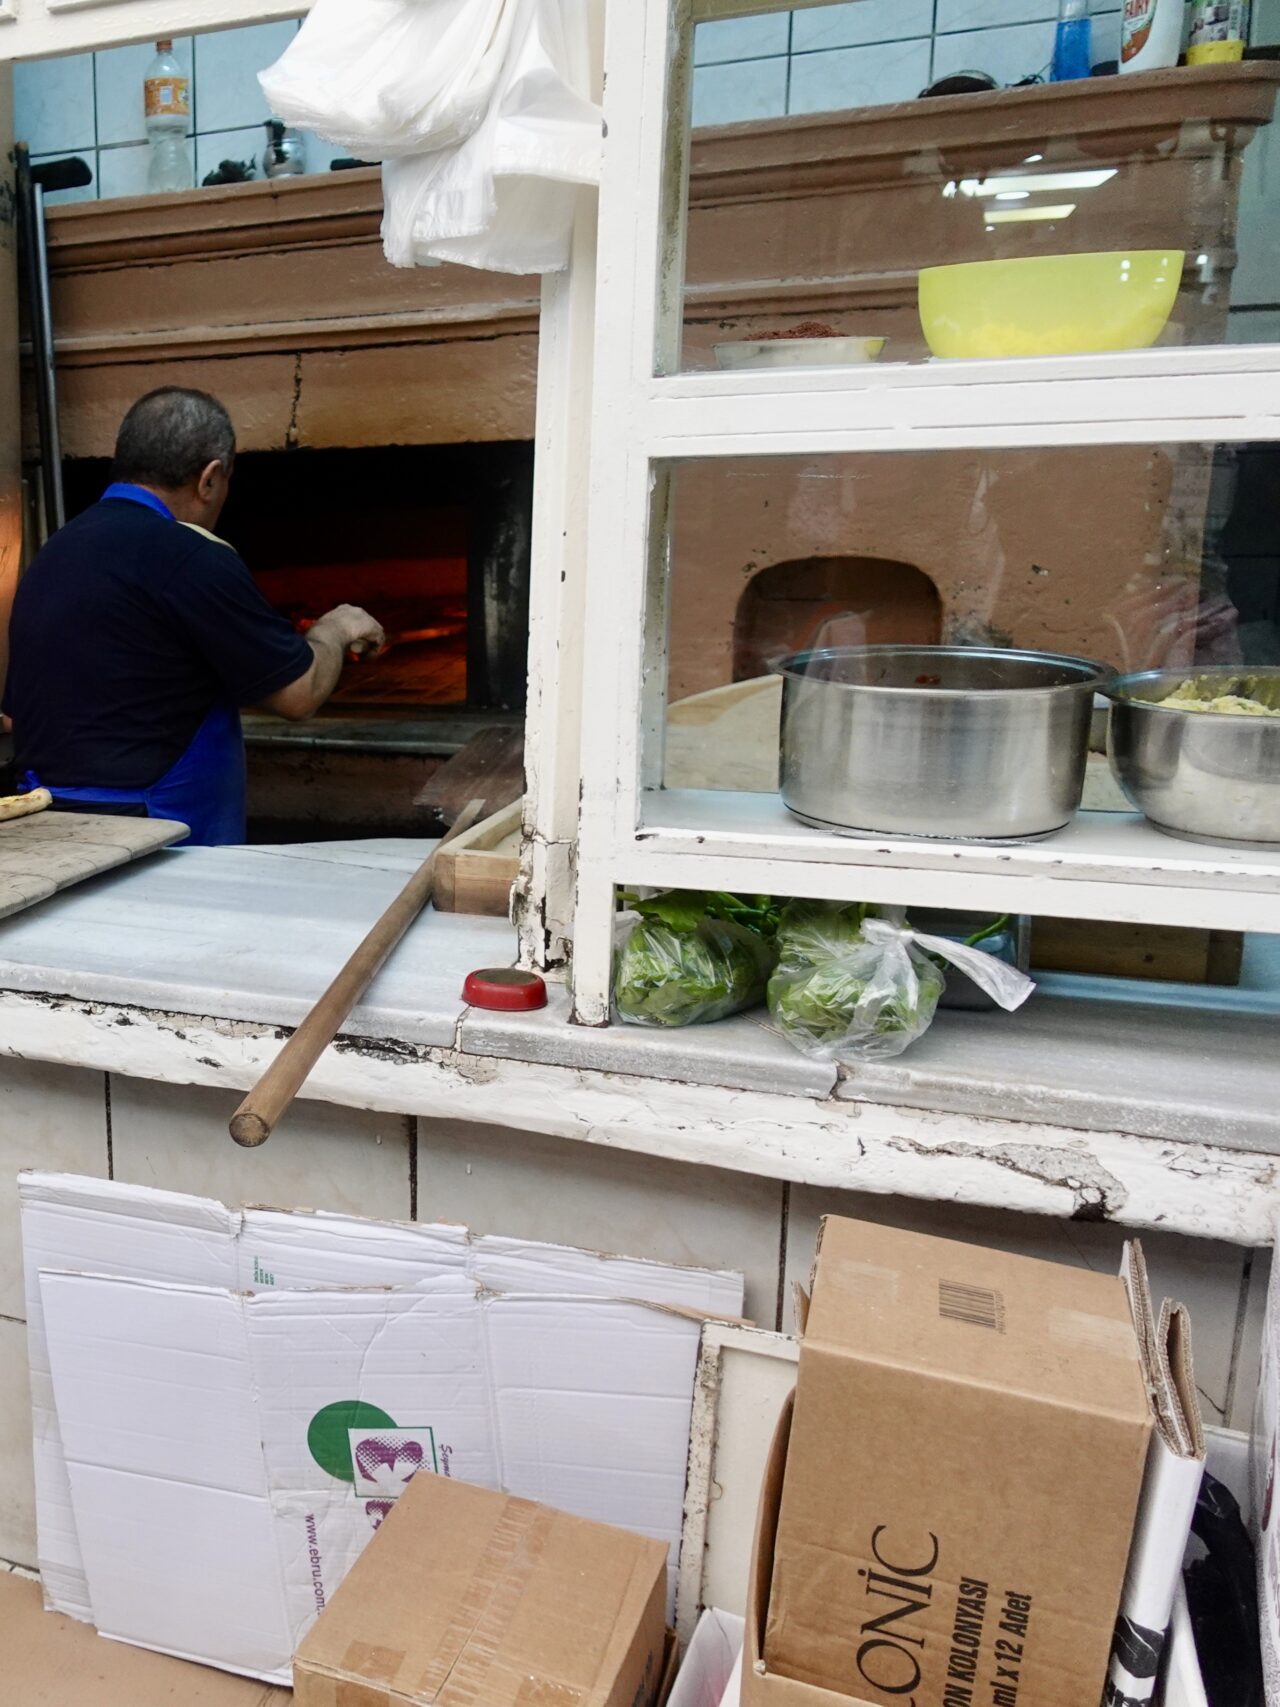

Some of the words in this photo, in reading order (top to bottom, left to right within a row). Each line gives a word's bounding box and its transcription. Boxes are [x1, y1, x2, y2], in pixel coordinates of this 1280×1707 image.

[305, 1513, 325, 1616] www.ebru.com.
[856, 1525, 939, 1707] ONİC
[948, 1576, 988, 1682] KOLONYASI
[999, 1591, 1032, 1638] Adet
[994, 1640, 1022, 1664] 12
[996, 1669, 1018, 1682] x
[943, 1684, 973, 1707] ON
[991, 1682, 1018, 1707] ml
